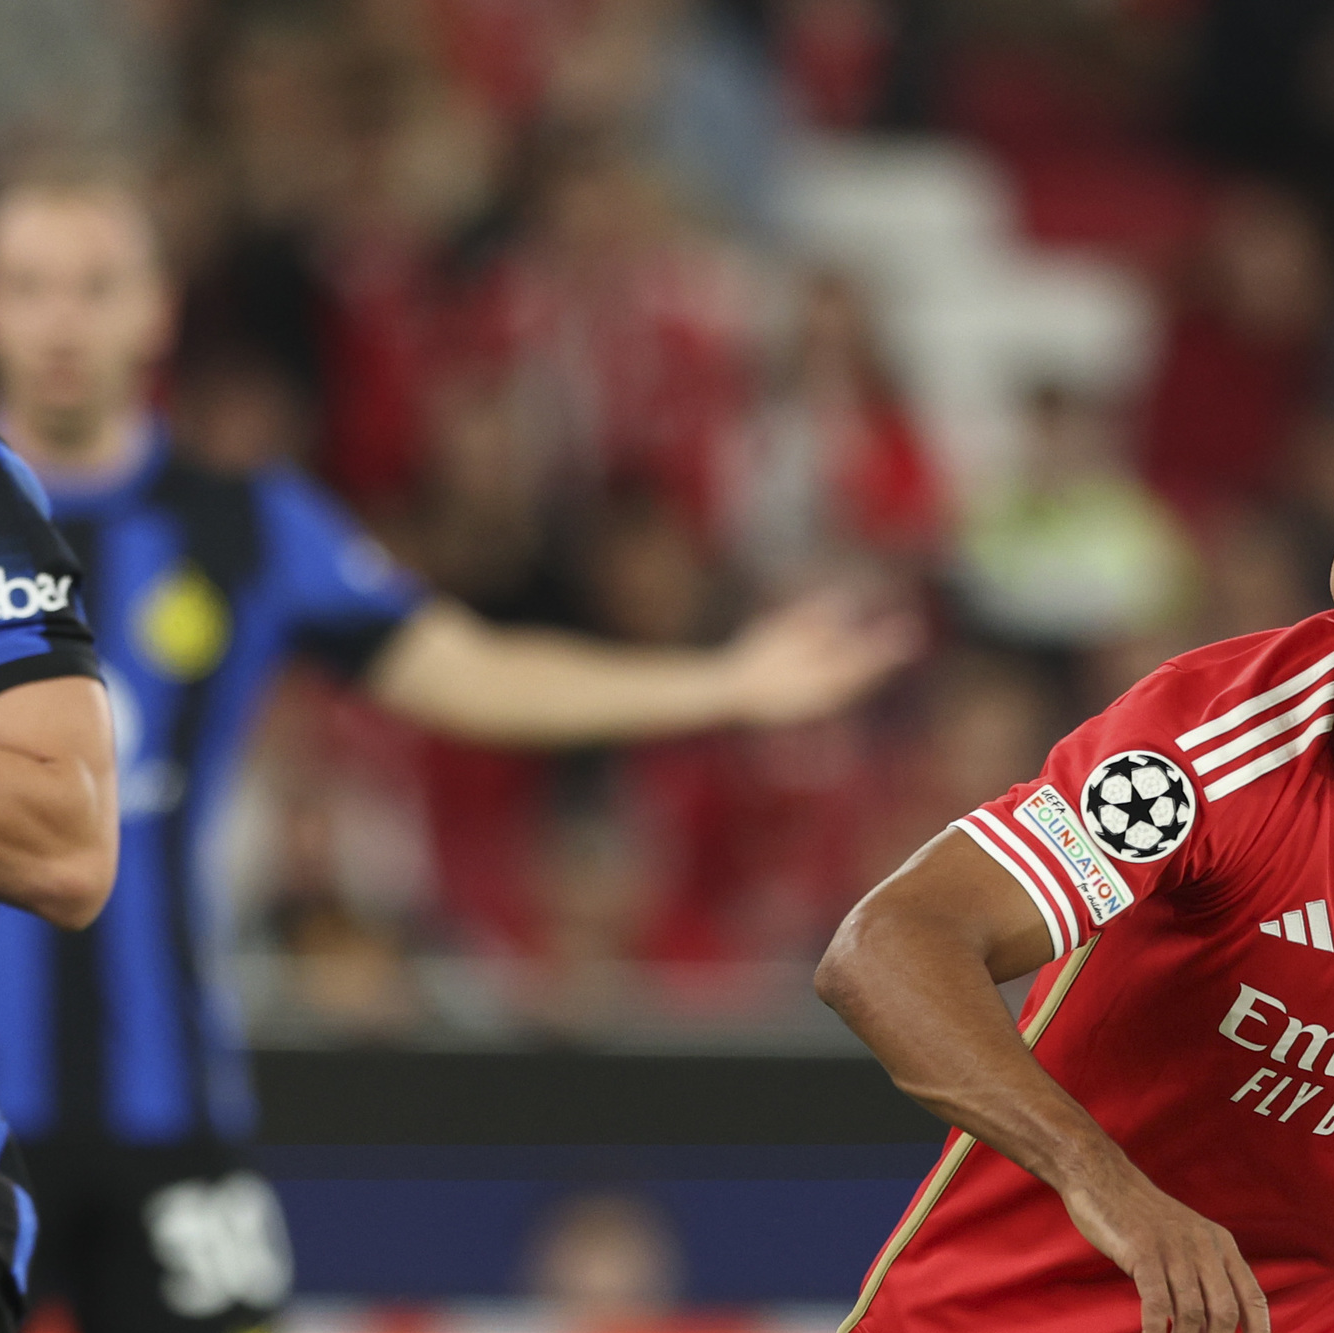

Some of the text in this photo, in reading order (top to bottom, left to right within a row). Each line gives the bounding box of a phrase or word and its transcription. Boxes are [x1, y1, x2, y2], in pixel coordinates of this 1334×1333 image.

[1041, 789, 1066, 814] UEFA
[1026, 796, 1121, 914] FOUNDATION
[1229, 1067, 1324, 1123] FLY
